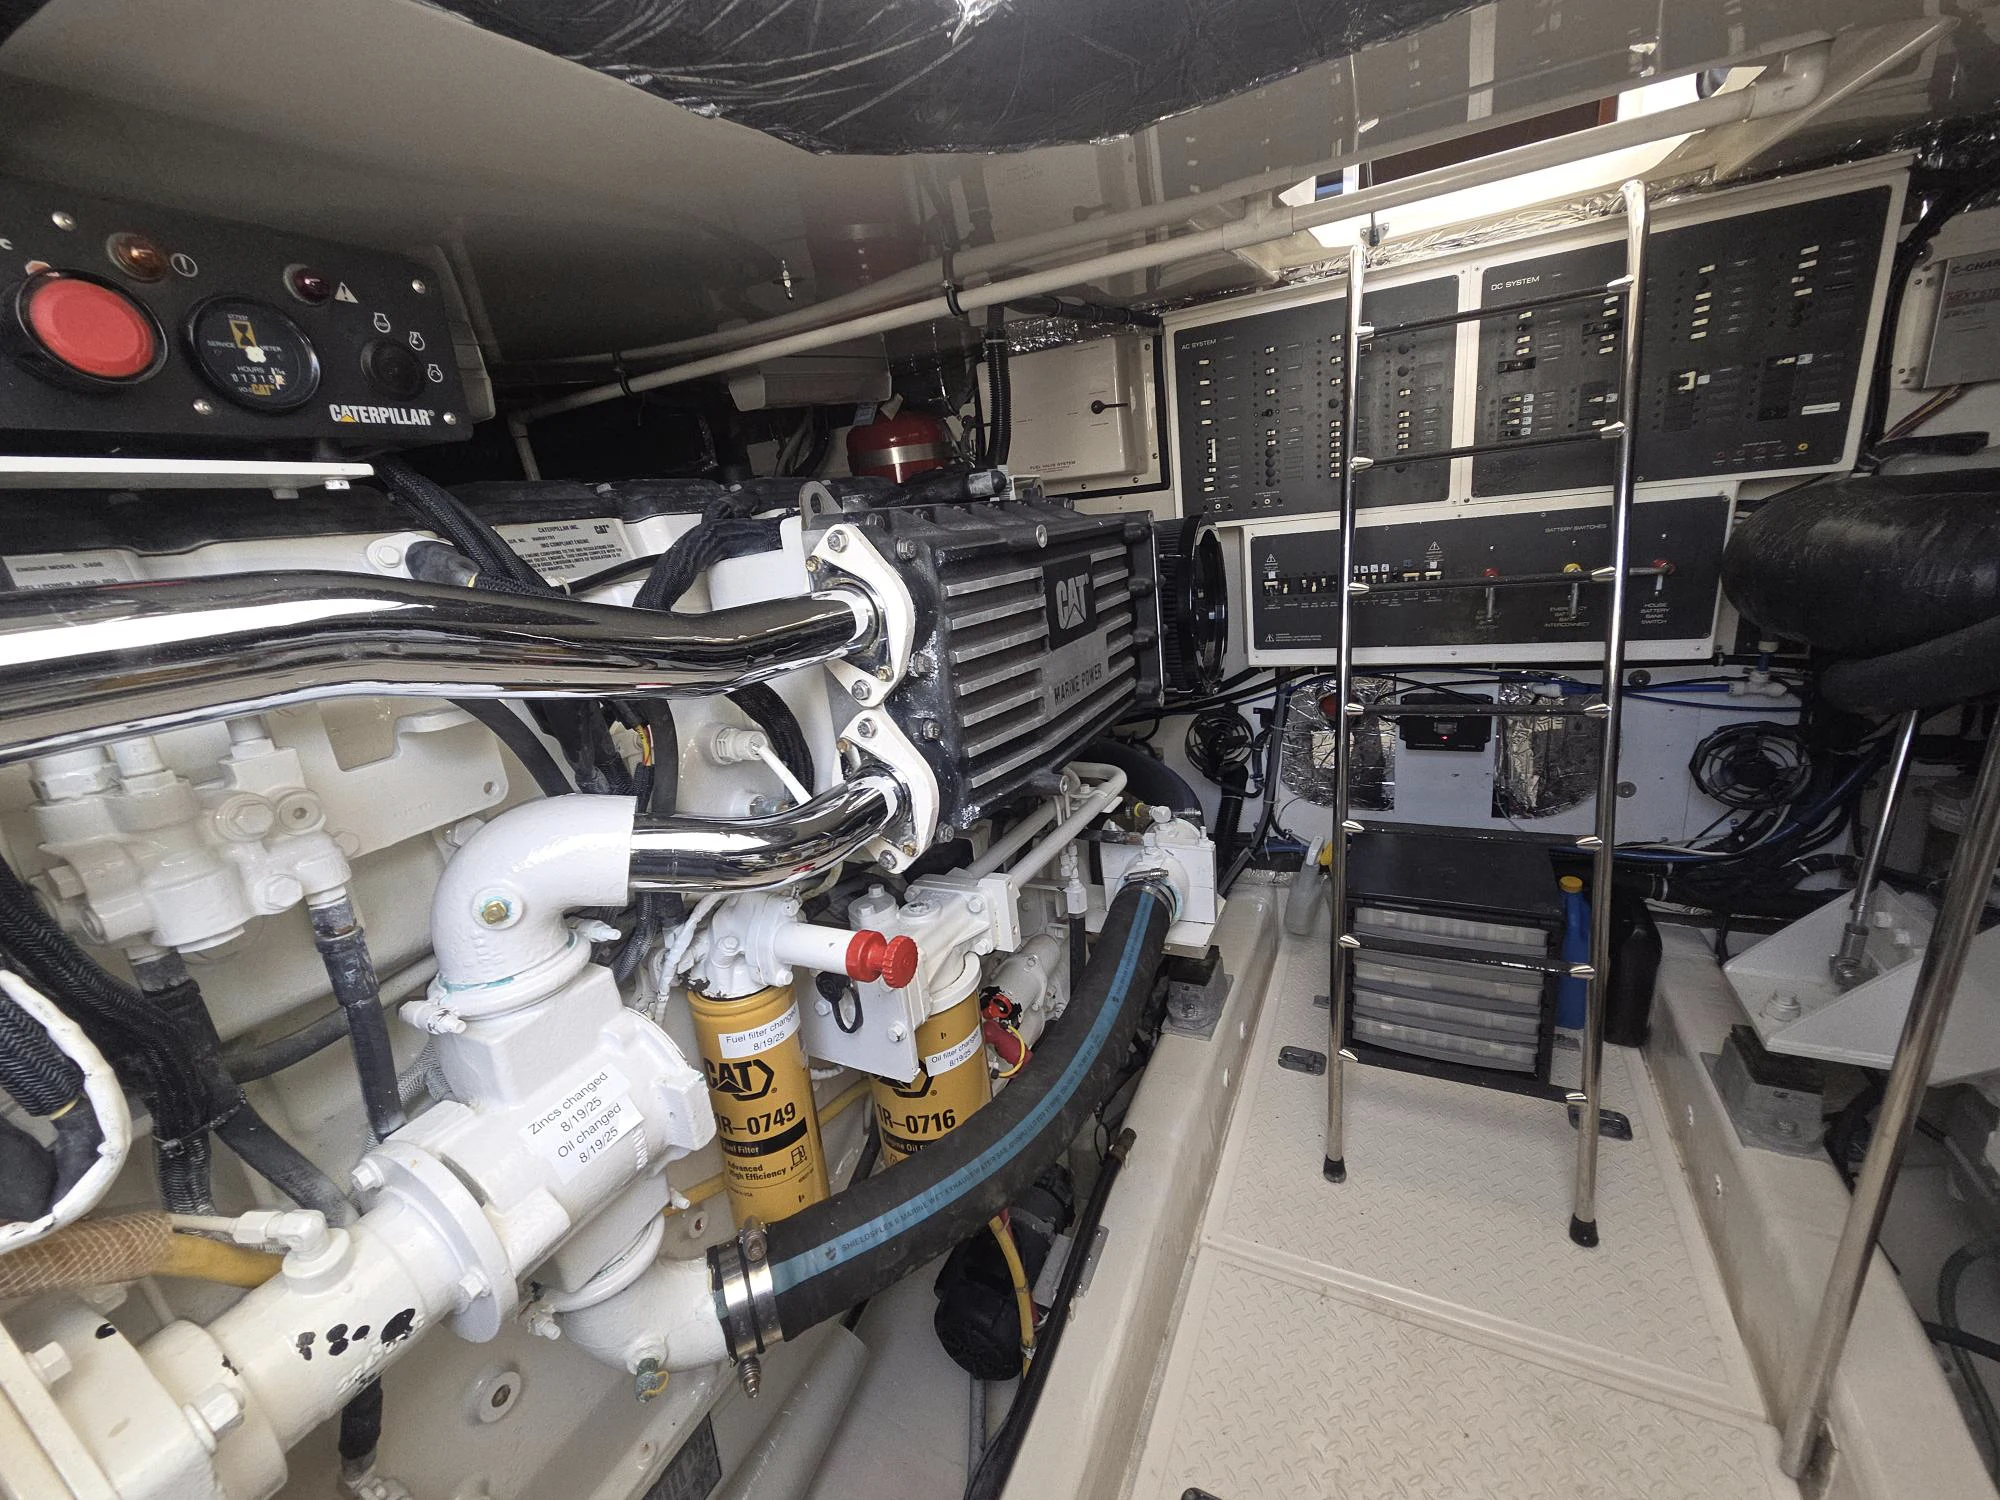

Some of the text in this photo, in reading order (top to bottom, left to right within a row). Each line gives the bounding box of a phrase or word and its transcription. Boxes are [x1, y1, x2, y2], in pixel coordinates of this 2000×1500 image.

[1491, 275, 1540, 291] DC SYSTEM
[207, 340, 236, 349] SERVICE
[1180, 338, 1217, 351] AC SYSTEM
[237, 366, 265, 374] HOURS
[328, 404, 432, 426] CATERPILLAR
[1544, 523, 1607, 534] BATTERY SWITCHES
[1056, 573, 1088, 630] CAT
[1053, 662, 1102, 706] MARINE POWER
[725, 1036, 747, 1044] Fuel
[748, 1026, 768, 1040] filter
[752, 1030, 786, 1051] 8/19/25
[931, 1054, 942, 1064] Oil
[943, 1047, 957, 1060] filter
[948, 1048, 972, 1067] 8/19/25
[703, 1057, 752, 1092] CAT
[527, 1071, 609, 1136] Zincs changed
[559, 1096, 603, 1133] 8/19/25
[557, 1102, 622, 1158] Oil changed
[578, 1125, 619, 1164] 8/19/25
[737, 1144, 760, 1155] Filter
[727, 1159, 764, 1173] Advanced
[745, 1166, 787, 1182] Efficiency
